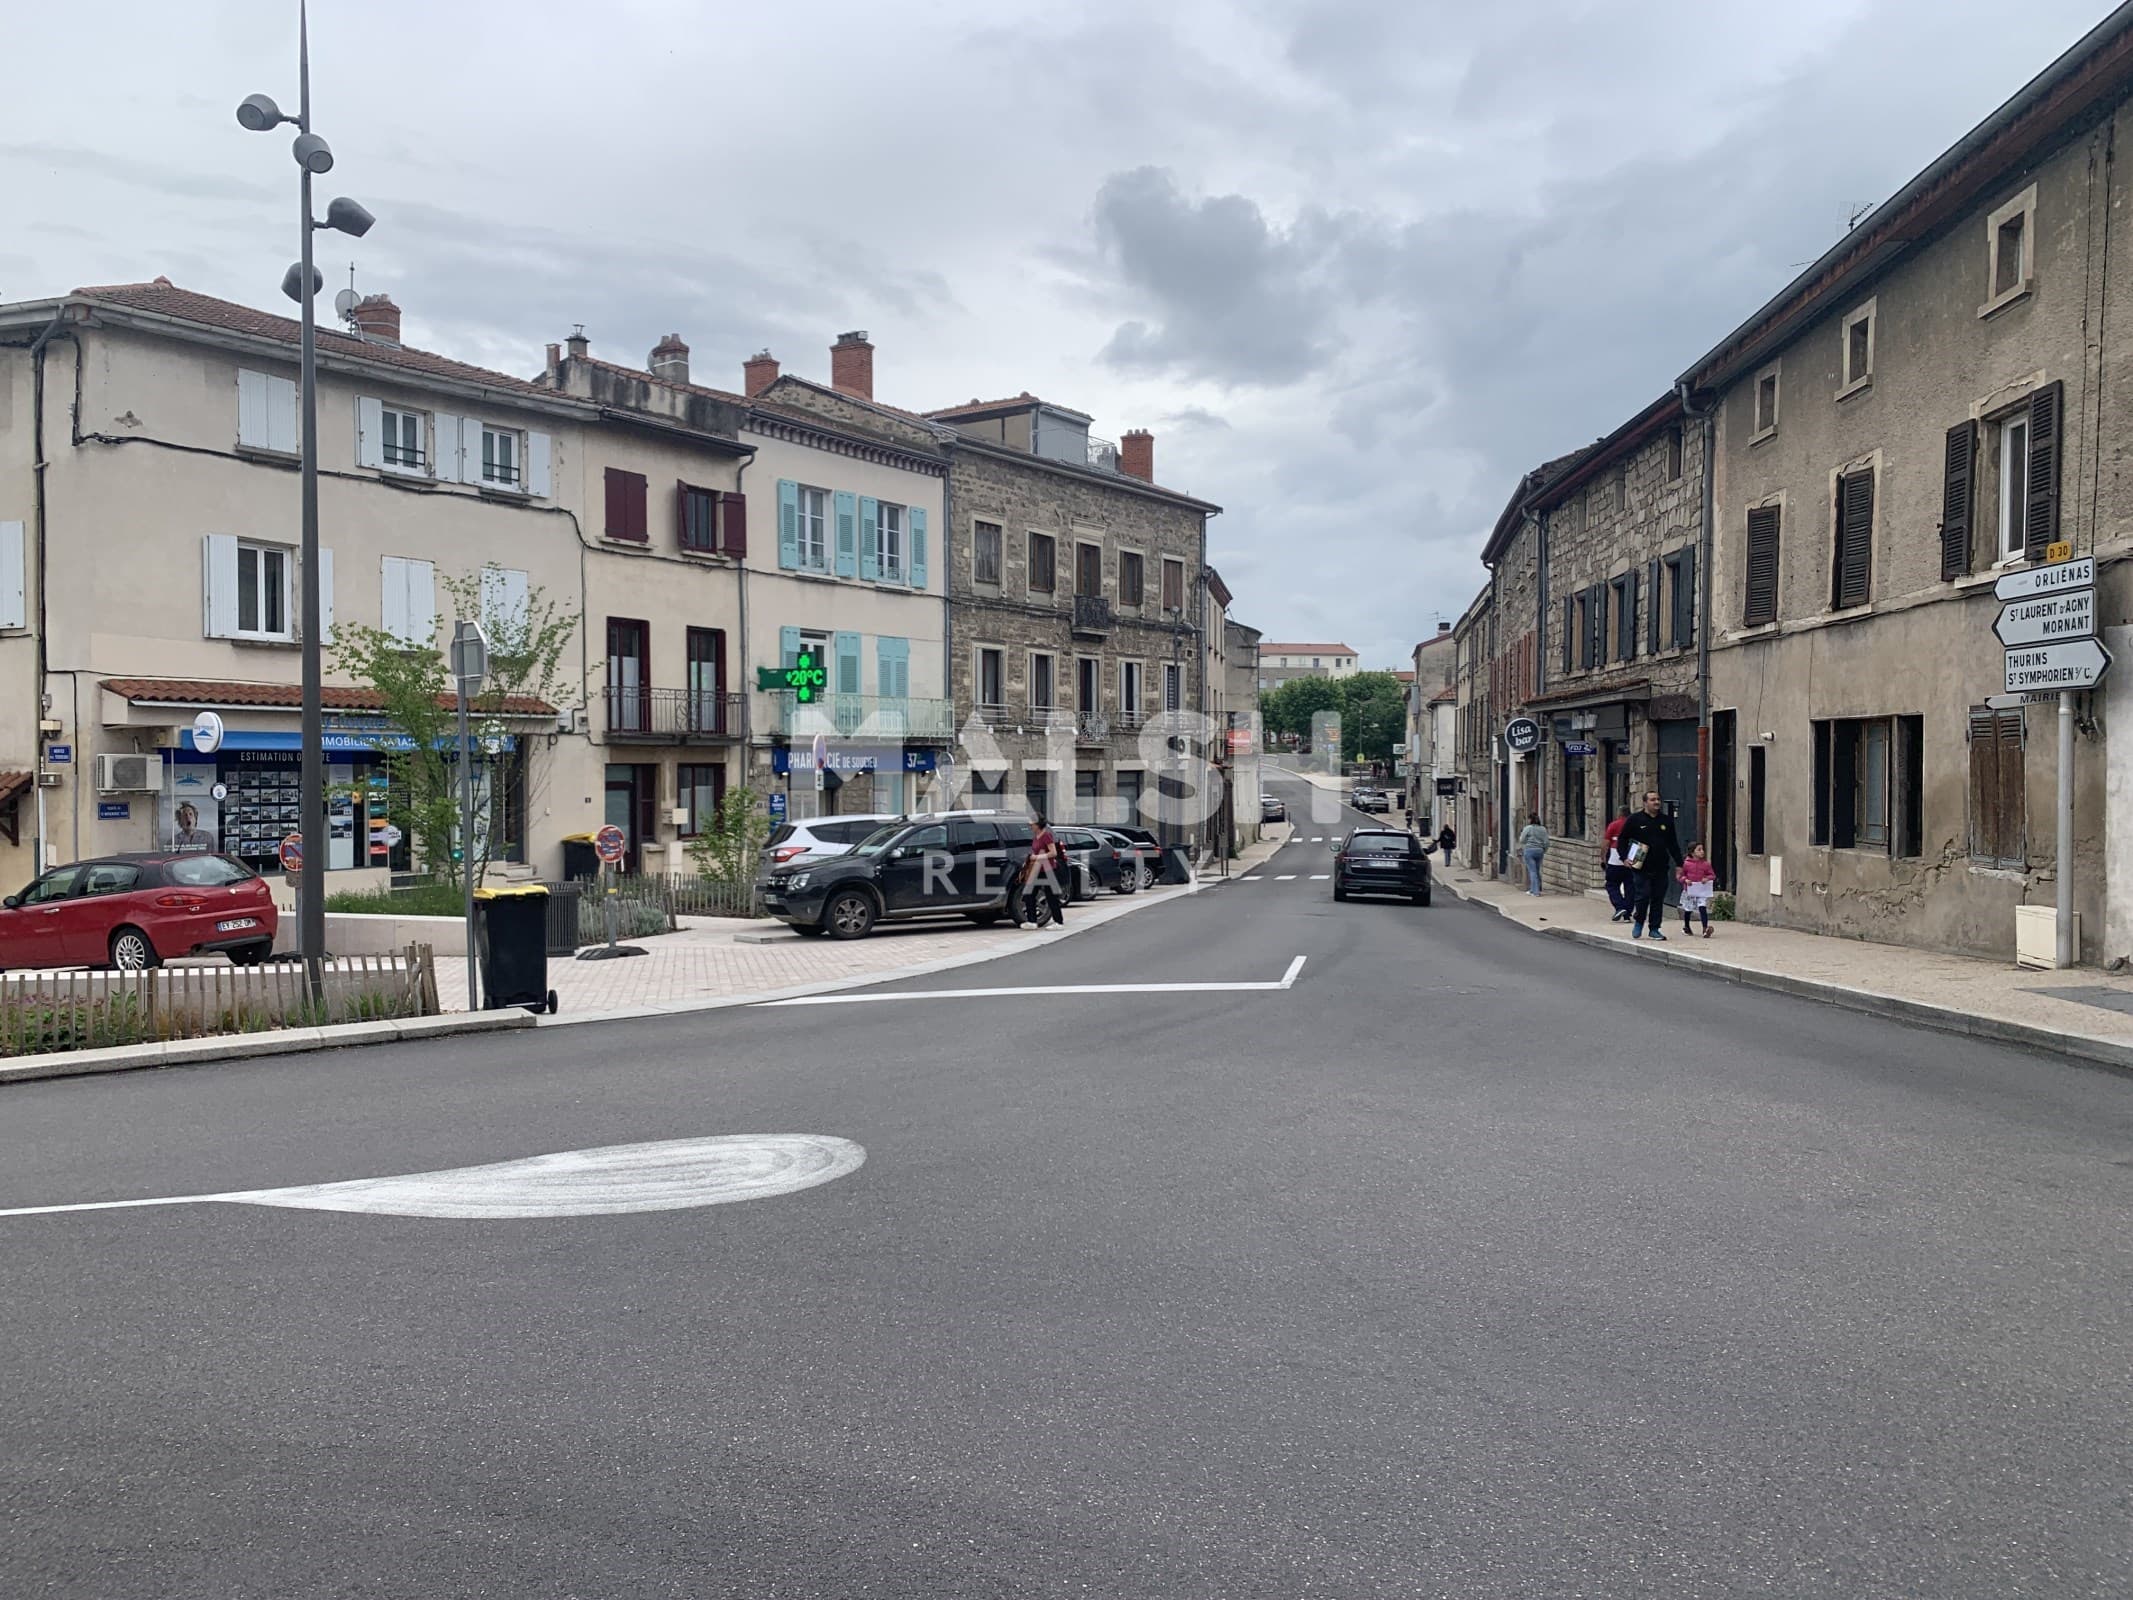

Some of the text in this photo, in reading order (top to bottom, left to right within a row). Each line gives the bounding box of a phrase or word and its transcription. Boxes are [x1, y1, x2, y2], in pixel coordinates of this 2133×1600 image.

[2050, 545, 2068, 558] D 30
[2035, 565, 2090, 587] ORLIÉNAS
[2020, 602, 2058, 620] LAURENT
[2043, 615, 2089, 634] MORNANT
[2008, 652, 2047, 668] THURINS
[2019, 667, 2074, 684] SYMPHORIEN
[1512, 726, 1532, 737] Lisa
[1515, 736, 1533, 746] bar
[240, 752, 294, 761] ESTIMATION
[788, 752, 841, 769] PHARCIE
[907, 753, 917, 767] 37
